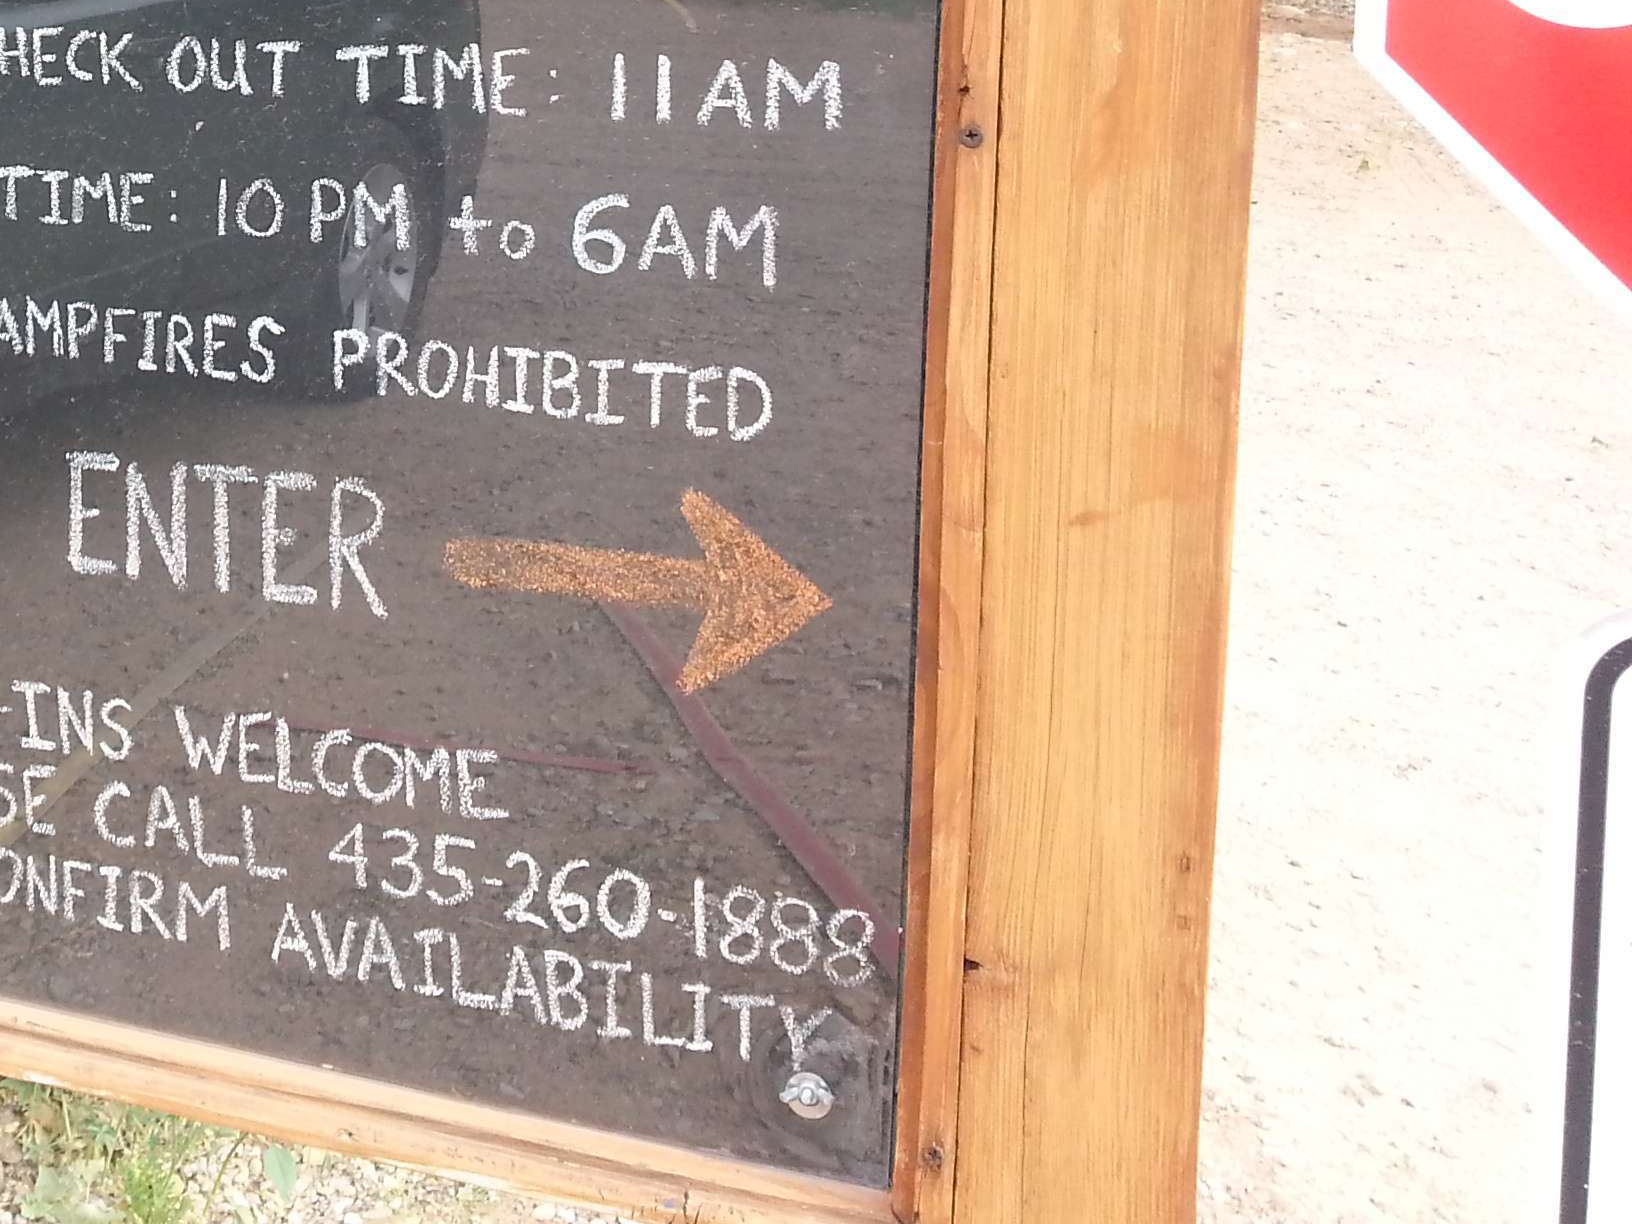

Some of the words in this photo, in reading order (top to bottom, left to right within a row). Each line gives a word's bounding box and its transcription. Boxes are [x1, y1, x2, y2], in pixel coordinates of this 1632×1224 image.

[166, 35, 302, 97] OUT
[448, 195, 536, 260] to
[332, 328, 772, 442] PROHIBITED
[66, 451, 387, 619] ENTER
[174, 705, 509, 820] WELCOME
[94, 780, 287, 881] CALL
[329, 822, 874, 987] 435-260-1888
[272, 903, 833, 1071] AVAILABILITY
